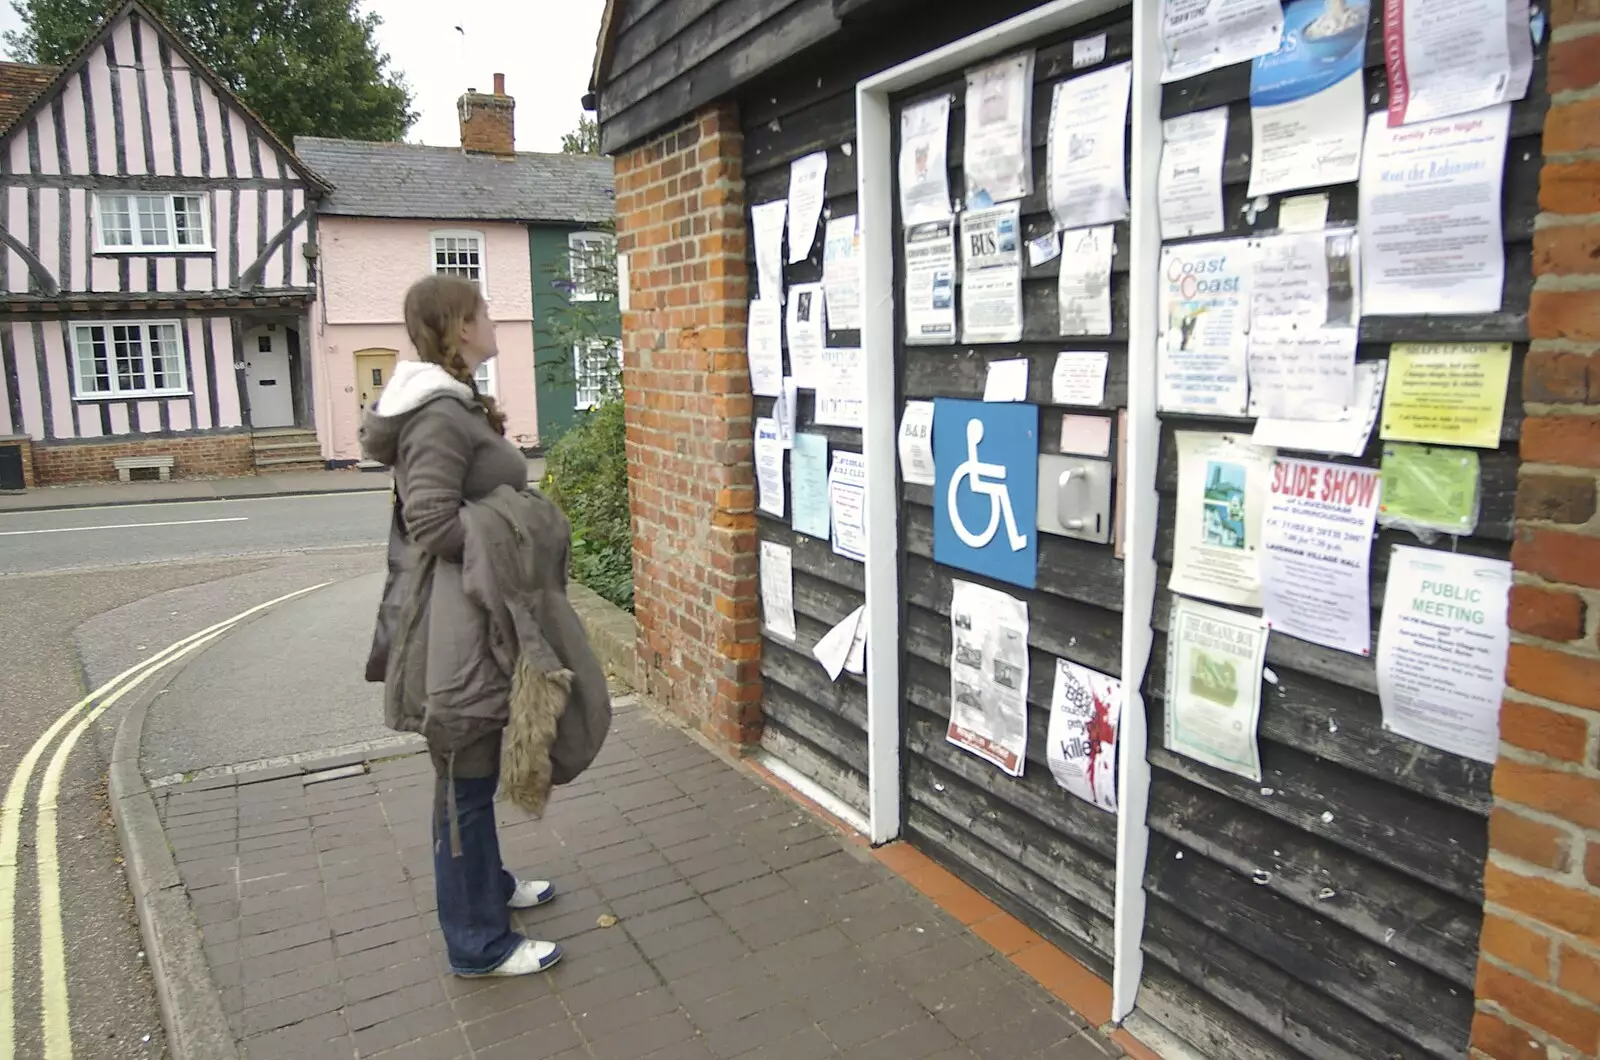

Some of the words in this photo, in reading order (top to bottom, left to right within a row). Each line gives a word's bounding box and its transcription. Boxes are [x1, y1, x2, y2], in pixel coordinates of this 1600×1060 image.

[971, 232, 997, 257] BUS
[1167, 256, 1227, 283] Coast
[1180, 276, 1240, 300] Coast
[1271, 462, 1318, 499] SLIDE
[1321, 467, 1377, 509] SHOW
[1422, 580, 1481, 602] PUBLIC
[1411, 597, 1485, 625] MEETING
[1060, 737, 1103, 761] killed
